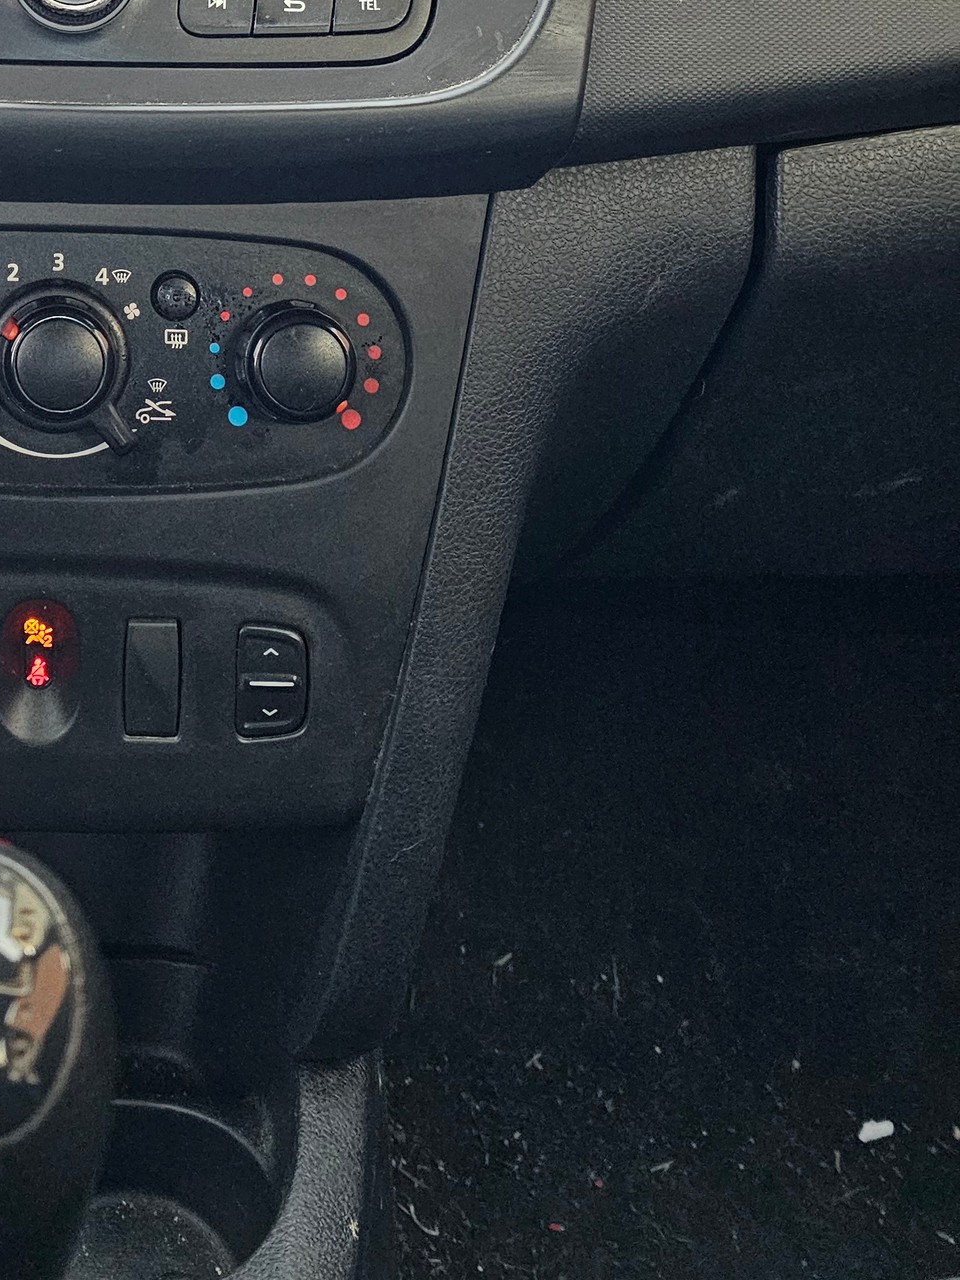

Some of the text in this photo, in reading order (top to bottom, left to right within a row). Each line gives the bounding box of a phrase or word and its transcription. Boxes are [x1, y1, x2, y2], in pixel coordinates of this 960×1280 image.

[52, 252, 65, 272] 3
[6, 263, 20, 282] 2
[95, 267, 110, 286] 4
